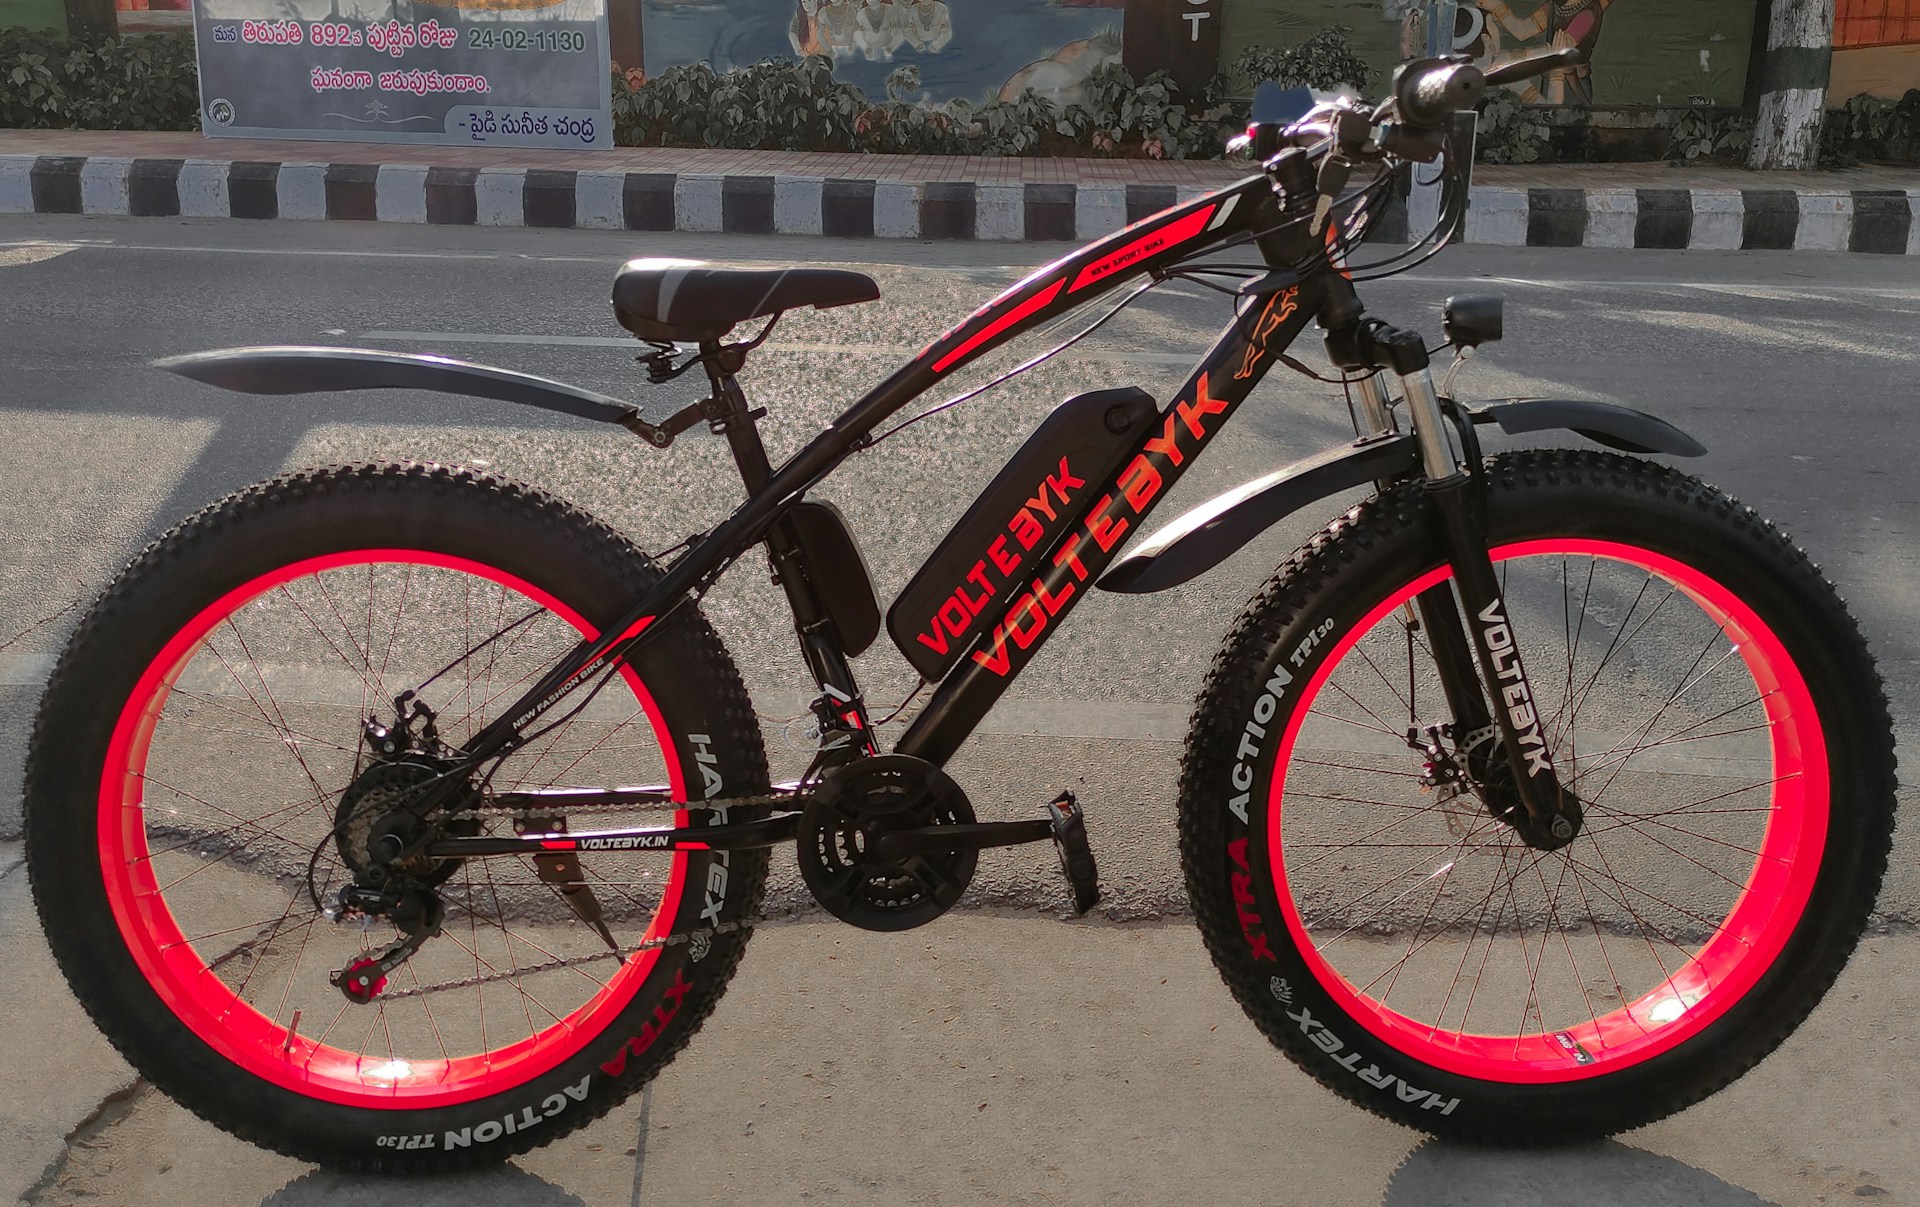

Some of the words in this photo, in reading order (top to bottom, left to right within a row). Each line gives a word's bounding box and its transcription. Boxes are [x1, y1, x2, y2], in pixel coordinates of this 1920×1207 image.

[214, 27, 237, 43] మన
[243, 21, 302, 44] తిరుపతి
[367, 20, 415, 56] పుట్టిన
[419, 20, 457, 47] రోజు
[468, 29, 585, 51] 24-02-1130
[312, 67, 372, 92] ఘనంగా
[379, 70, 491, 95] జరుపుకుందాం.
[470, 109, 497, 141] పైడి
[501, 111, 549, 135] సునీత
[552, 115, 596, 143] చంద్ర
[1090, 263, 1111, 277] NEW
[1112, 248, 1142, 266] SPORT
[1144, 238, 1164, 251] BIKE
[917, 456, 1086, 655] VOLTEBYK
[972, 371, 1229, 677] VOLTEBYK
[512, 708, 537, 730] NEW
[537, 677, 580, 712] FASHION
[579, 657, 605, 680] BIKE
[1478, 598, 1552, 778] VOLTEBYK
[1228, 663, 1294, 825] ACTION
[580, 835, 670, 850] VOLTEBYK.IN
[1227, 837, 1276, 962] XTRA
[600, 967, 693, 1076] XTRA
[1286, 1006, 1461, 1117] HARTEX
[443, 1074, 592, 1151] ACTION
